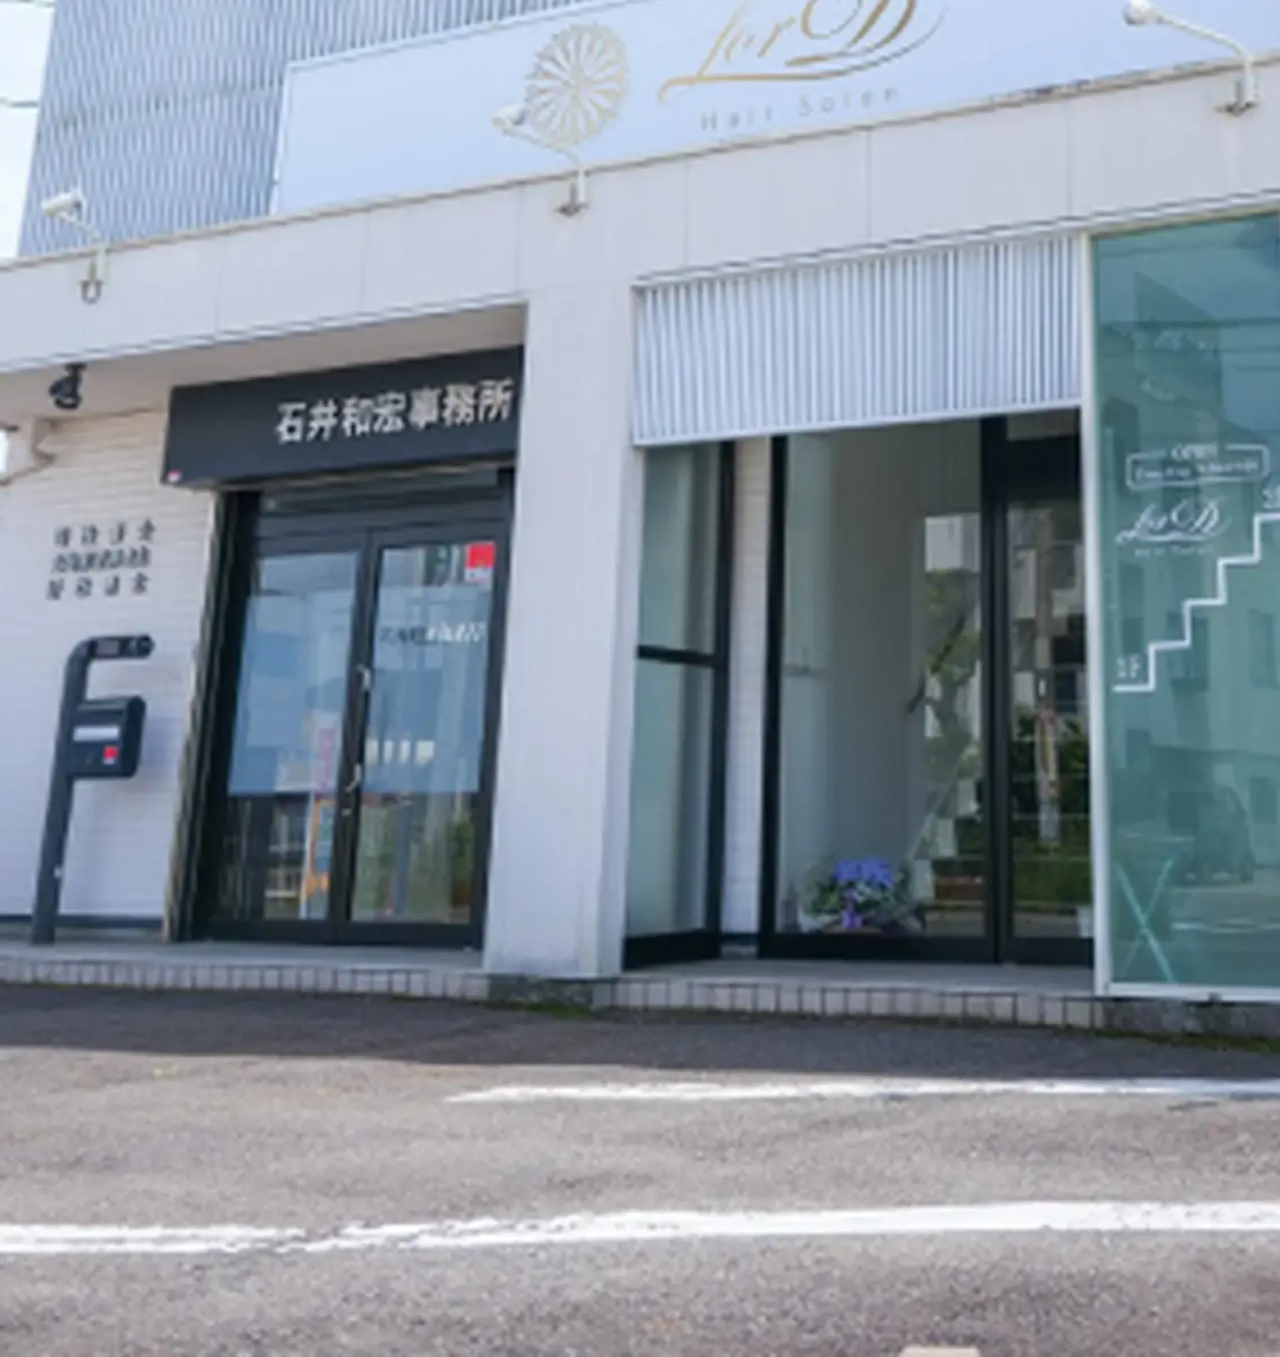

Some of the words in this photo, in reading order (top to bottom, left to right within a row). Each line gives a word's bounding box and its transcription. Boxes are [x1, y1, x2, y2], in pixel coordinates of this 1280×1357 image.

[276, 376, 514, 445] 石井和宏事務所
